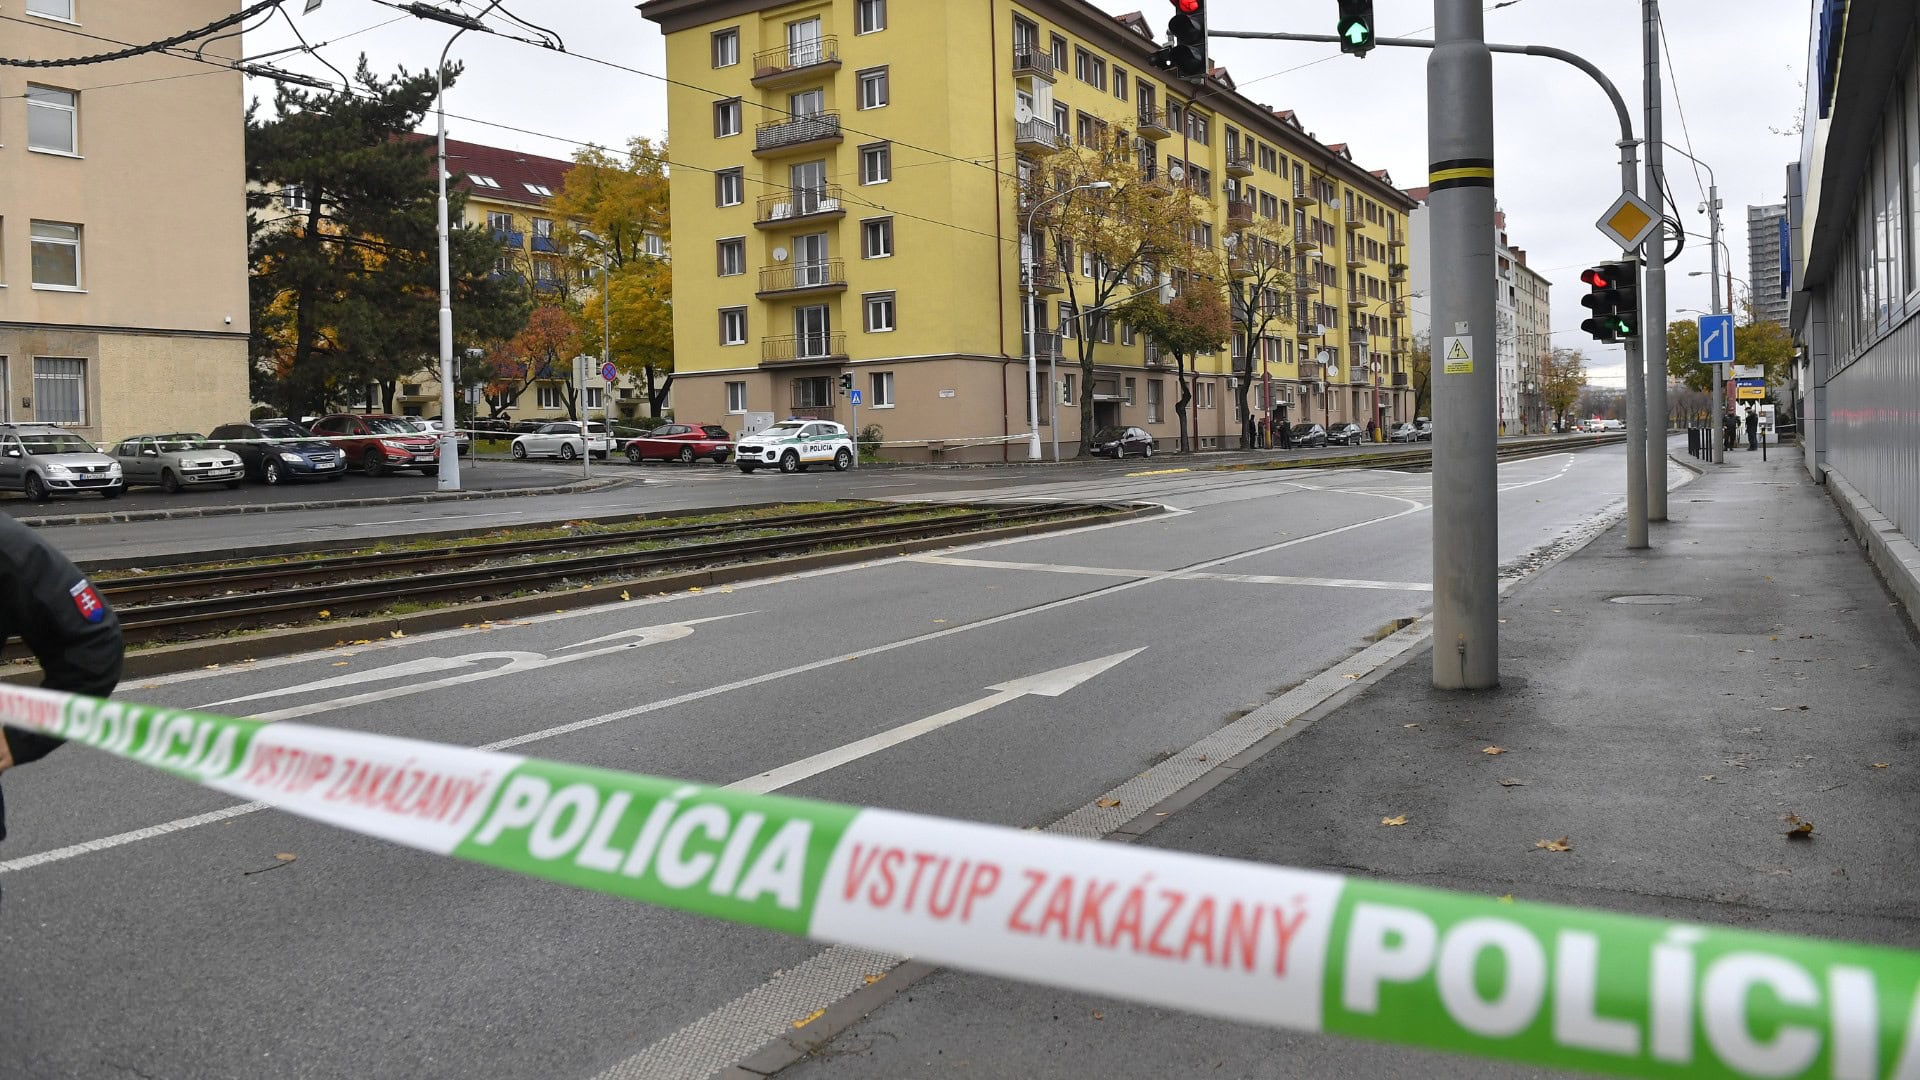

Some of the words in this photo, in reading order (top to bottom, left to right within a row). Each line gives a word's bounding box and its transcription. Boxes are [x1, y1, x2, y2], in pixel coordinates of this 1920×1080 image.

[809, 444, 833, 452] POLÍCIA
[244, 742, 335, 793] VSTUP
[322, 757, 492, 826] ZAKÁZANÝ
[476, 772, 814, 911] POLÍCIA
[841, 842, 1003, 923] VSTUP
[1007, 870, 1308, 979] ZAKÁZANÝ
[1341, 901, 1920, 1080] POLÍCI
